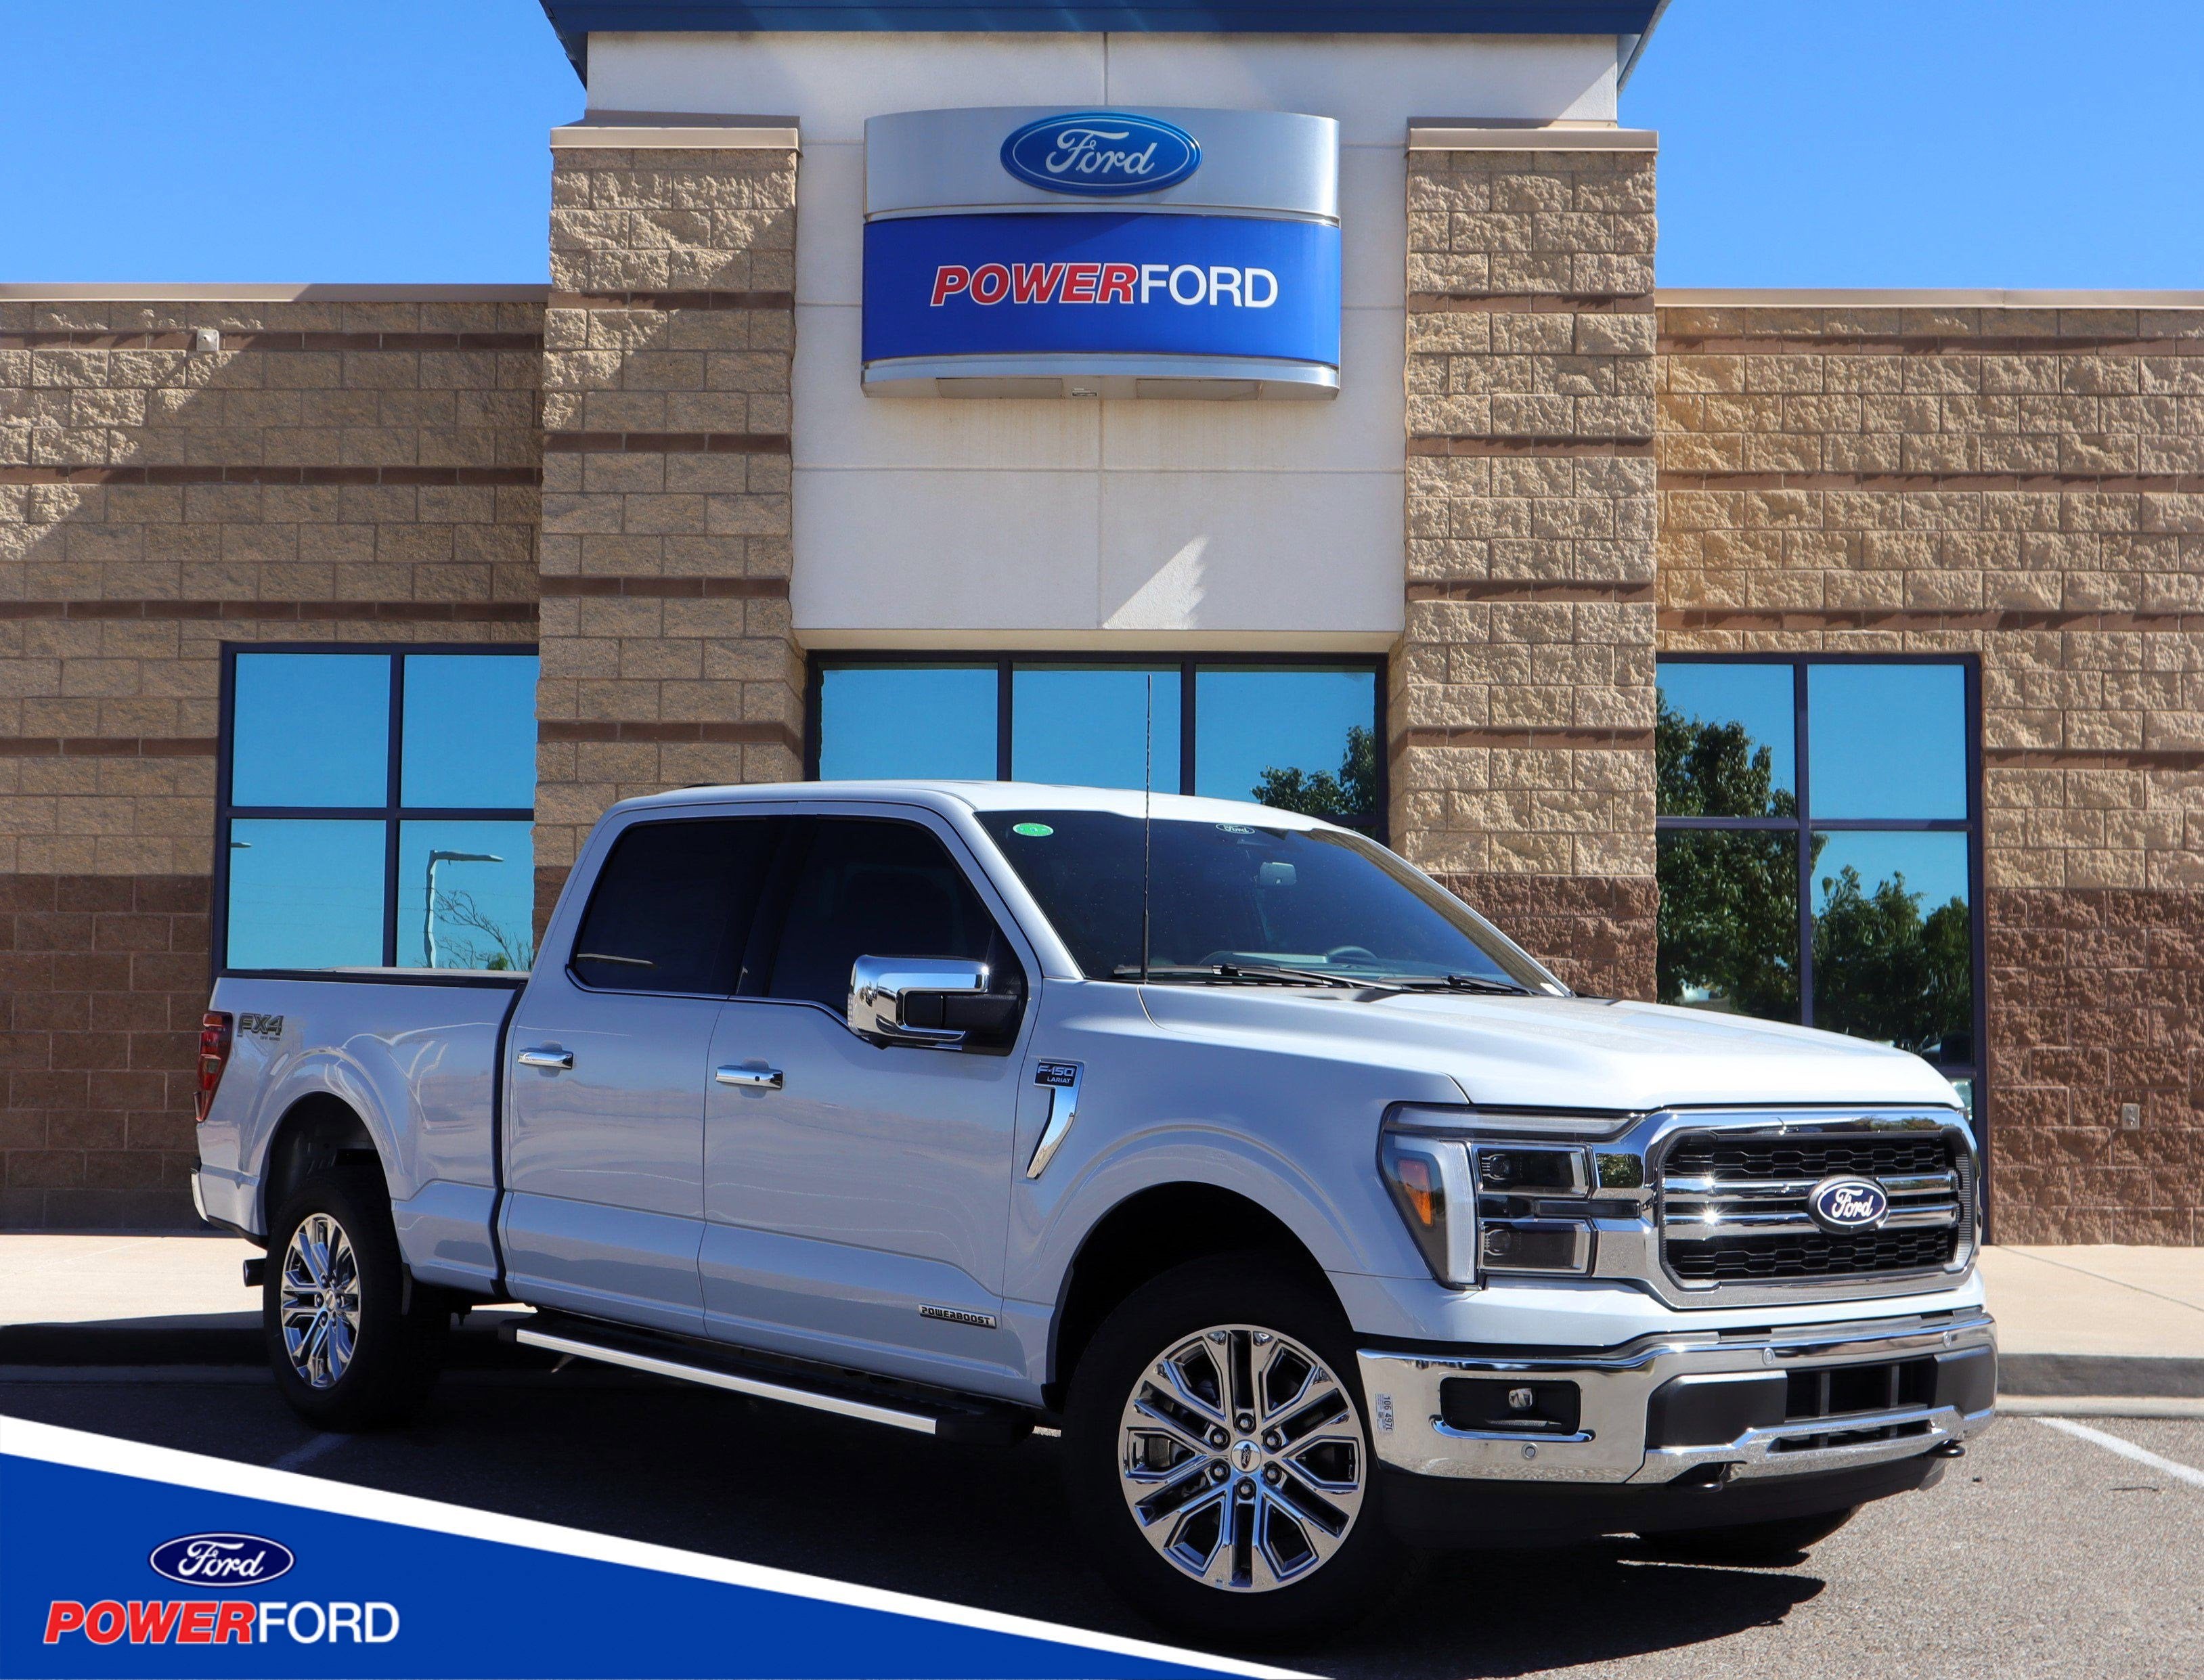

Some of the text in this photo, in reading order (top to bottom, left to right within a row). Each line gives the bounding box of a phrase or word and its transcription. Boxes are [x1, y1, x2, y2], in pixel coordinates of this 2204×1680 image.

[1045, 128, 1157, 175] Ford
[237, 1012, 284, 1037] FX4
[1037, 1065, 1076, 1077] F-150
[1046, 1076, 1071, 1084] LARIAT
[1831, 1188, 1874, 1218] Ford
[921, 1306, 990, 1325] POWERBOOST
[1384, 1396, 1392, 1411] 106
